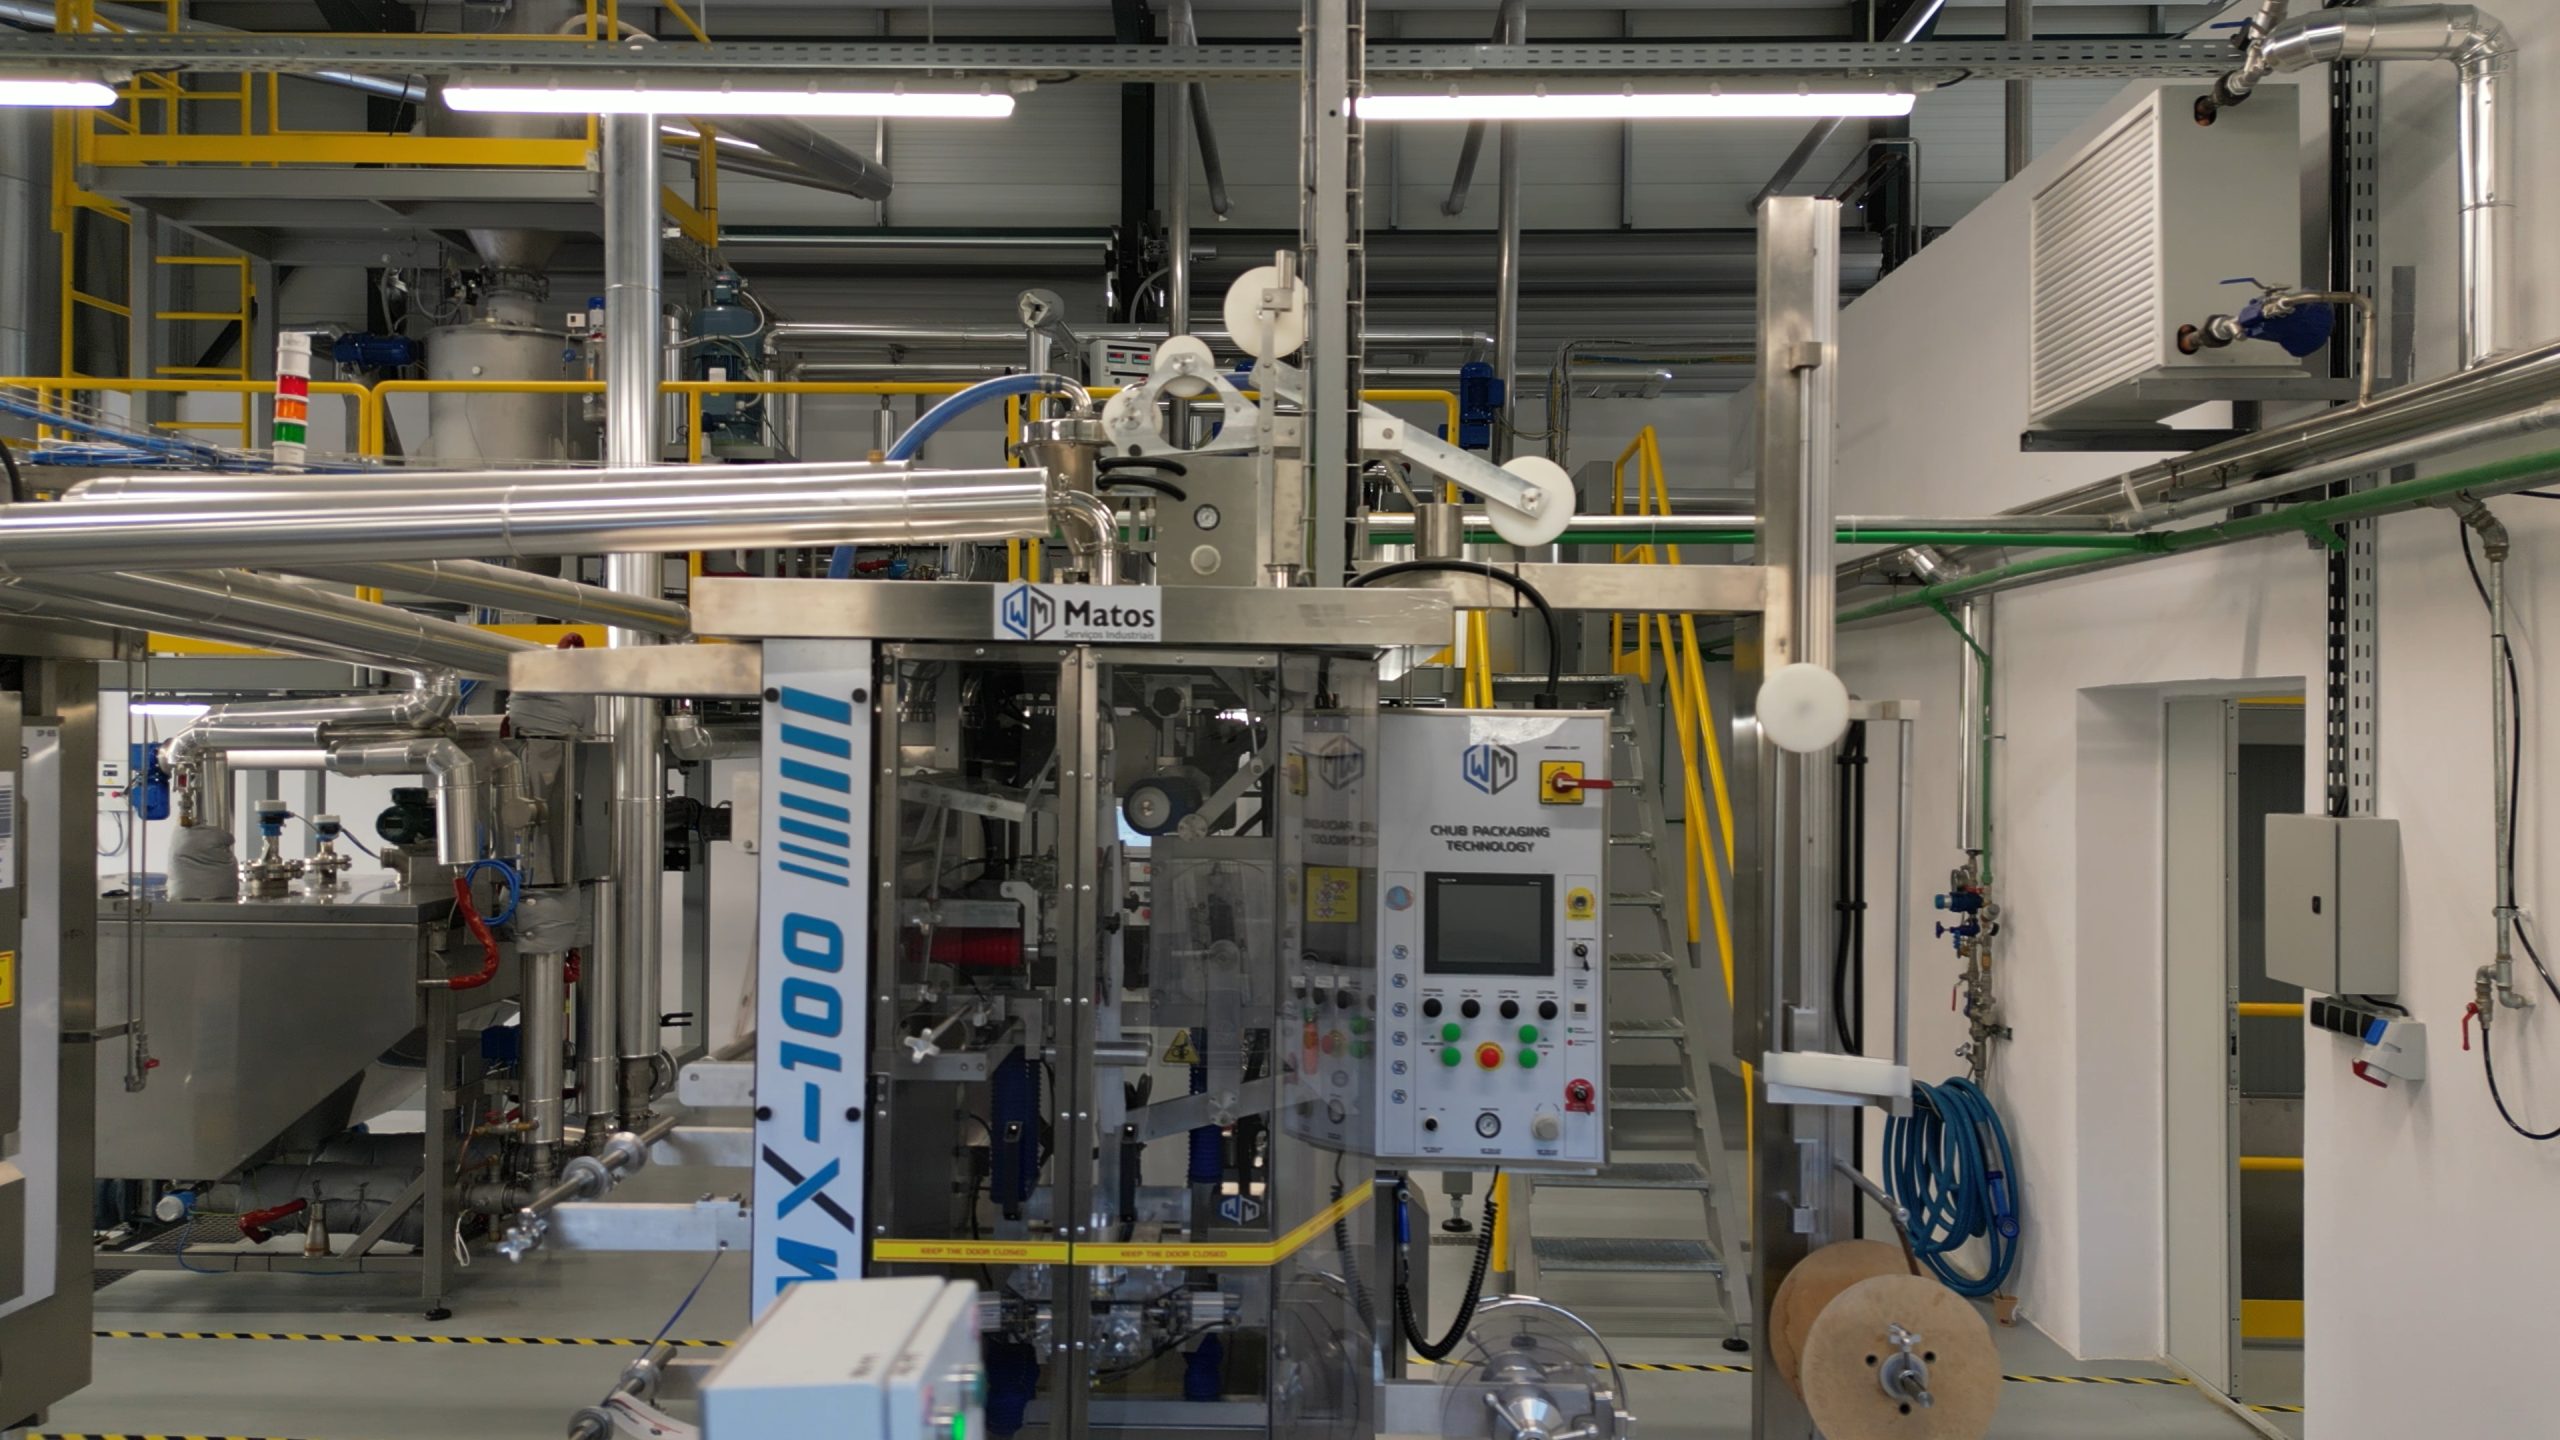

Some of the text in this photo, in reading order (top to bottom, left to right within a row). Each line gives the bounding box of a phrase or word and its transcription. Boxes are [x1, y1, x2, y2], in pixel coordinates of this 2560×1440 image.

[1064, 600, 1155, 627] Matos
[1064, 630, 1155, 641] Serviços Industriais
[1430, 825, 1550, 838] CHUB PACKAGING
[1446, 840, 1535, 852] TECHNOLOGY
[966, 1248, 991, 1256] DOOR
[993, 1249, 1027, 1257] CLOSED
[1120, 1250, 1228, 1258] KEEP THE DOOR CLOSED
